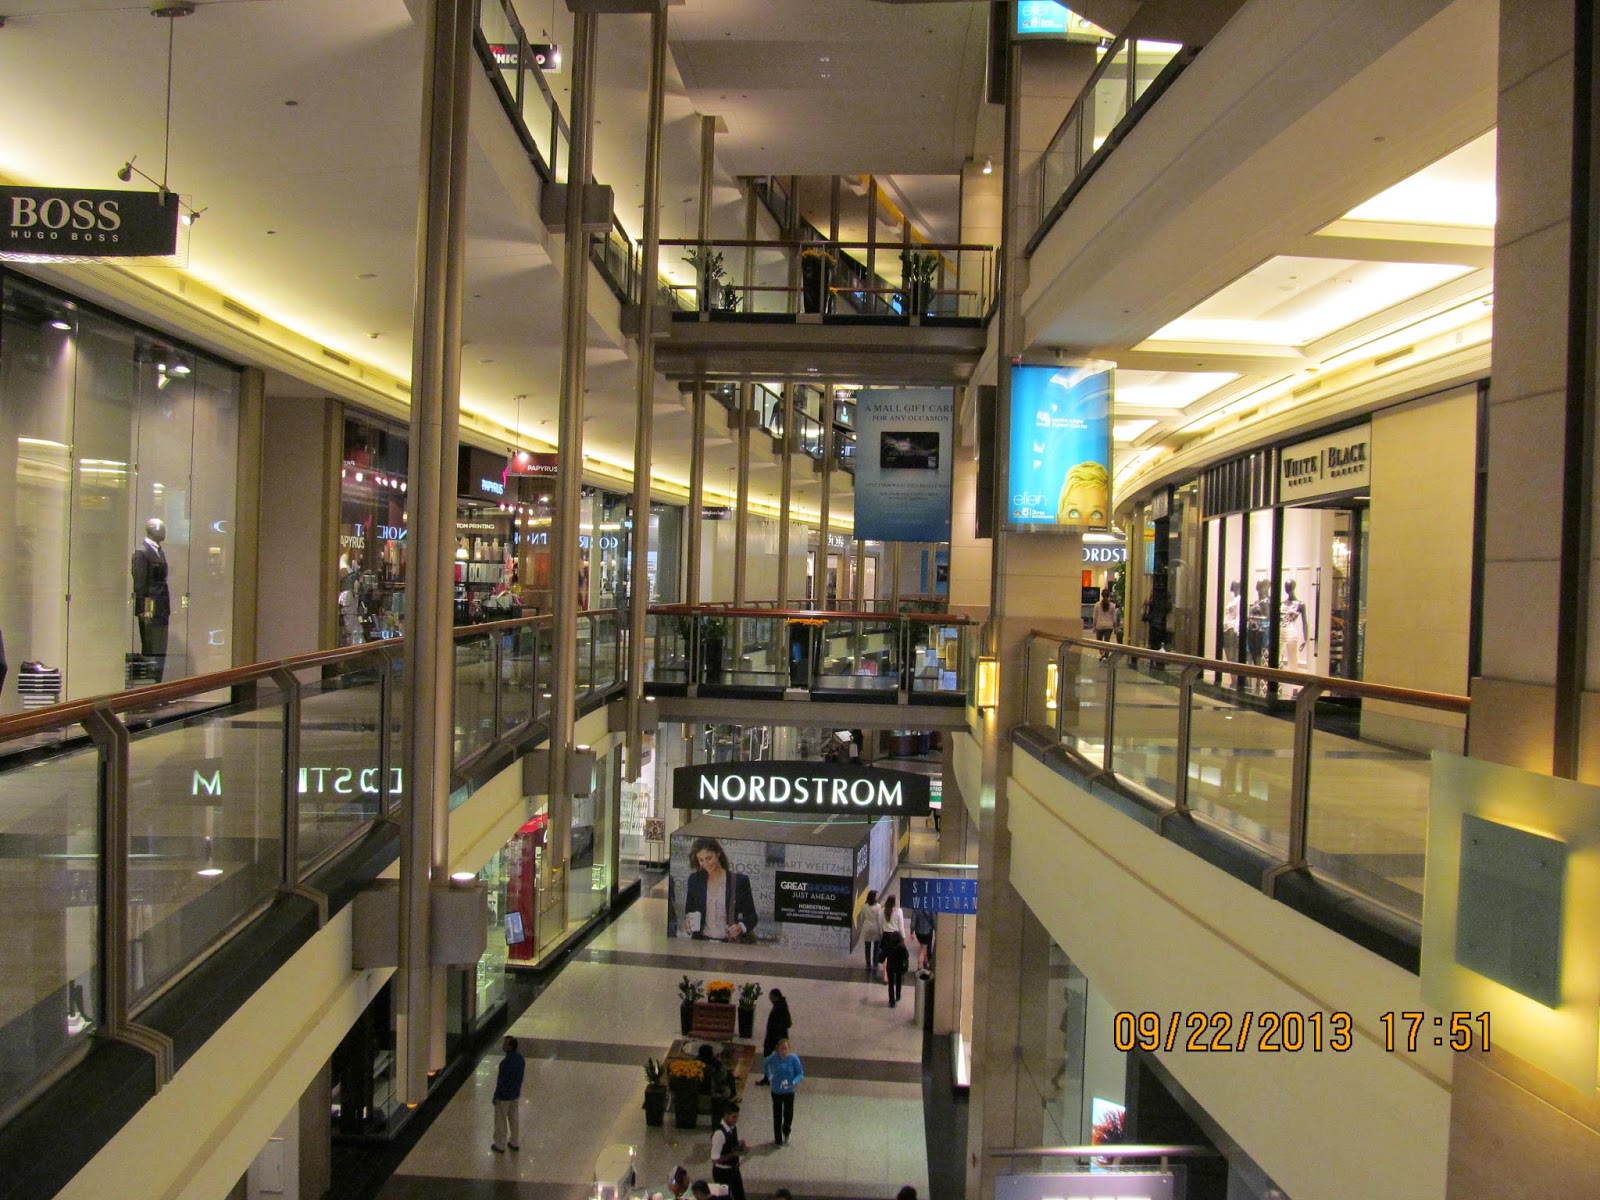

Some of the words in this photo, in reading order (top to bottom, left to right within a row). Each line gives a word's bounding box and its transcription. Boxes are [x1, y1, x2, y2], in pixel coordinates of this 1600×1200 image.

[10, 196, 121, 231] BOSS
[11, 230, 58, 240] HUGO
[71, 232, 119, 243] BOSS
[865, 404, 871, 412] A
[874, 404, 901, 412] MALL
[904, 404, 926, 412] GIFT
[1283, 455, 1318, 478] WHITE
[1328, 442, 1367, 468] BLACK
[1013, 491, 1047, 506] ellen
[700, 774, 903, 806] NORDSTROM
[912, 881, 978, 894] STUART
[792, 891, 809, 899] JUST
[810, 893, 836, 901] AHEAD
[912, 897, 978, 909] WEITZMAN
